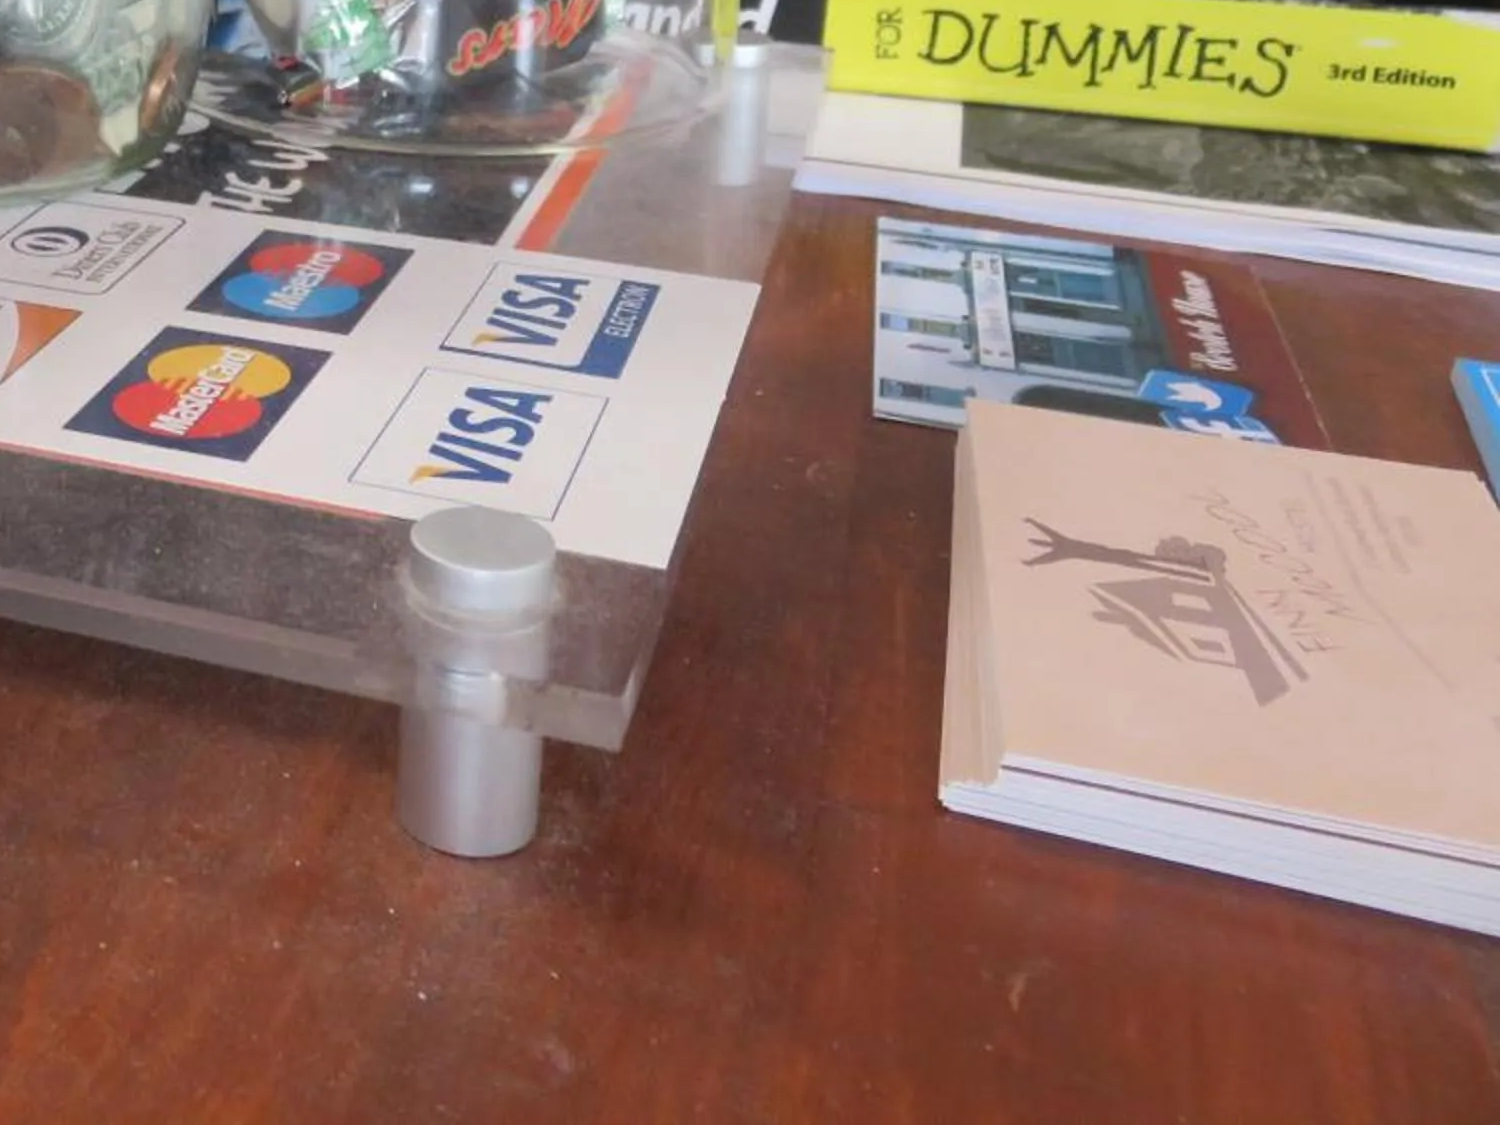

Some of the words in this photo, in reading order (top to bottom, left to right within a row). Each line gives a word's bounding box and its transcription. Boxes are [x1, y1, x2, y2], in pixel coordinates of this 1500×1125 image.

[876, 7, 902, 60] FOR
[918, 8, 1297, 99] DUMMIES
[1327, 62, 1367, 85] 3rd
[1373, 65, 1457, 90] Edition
[263, 250, 343, 312] Maestro
[473, 274, 591, 348] VISA
[603, 284, 650, 339] ELECTRON
[149, 345, 255, 436] MasterCard
[409, 386, 554, 486] VISA
